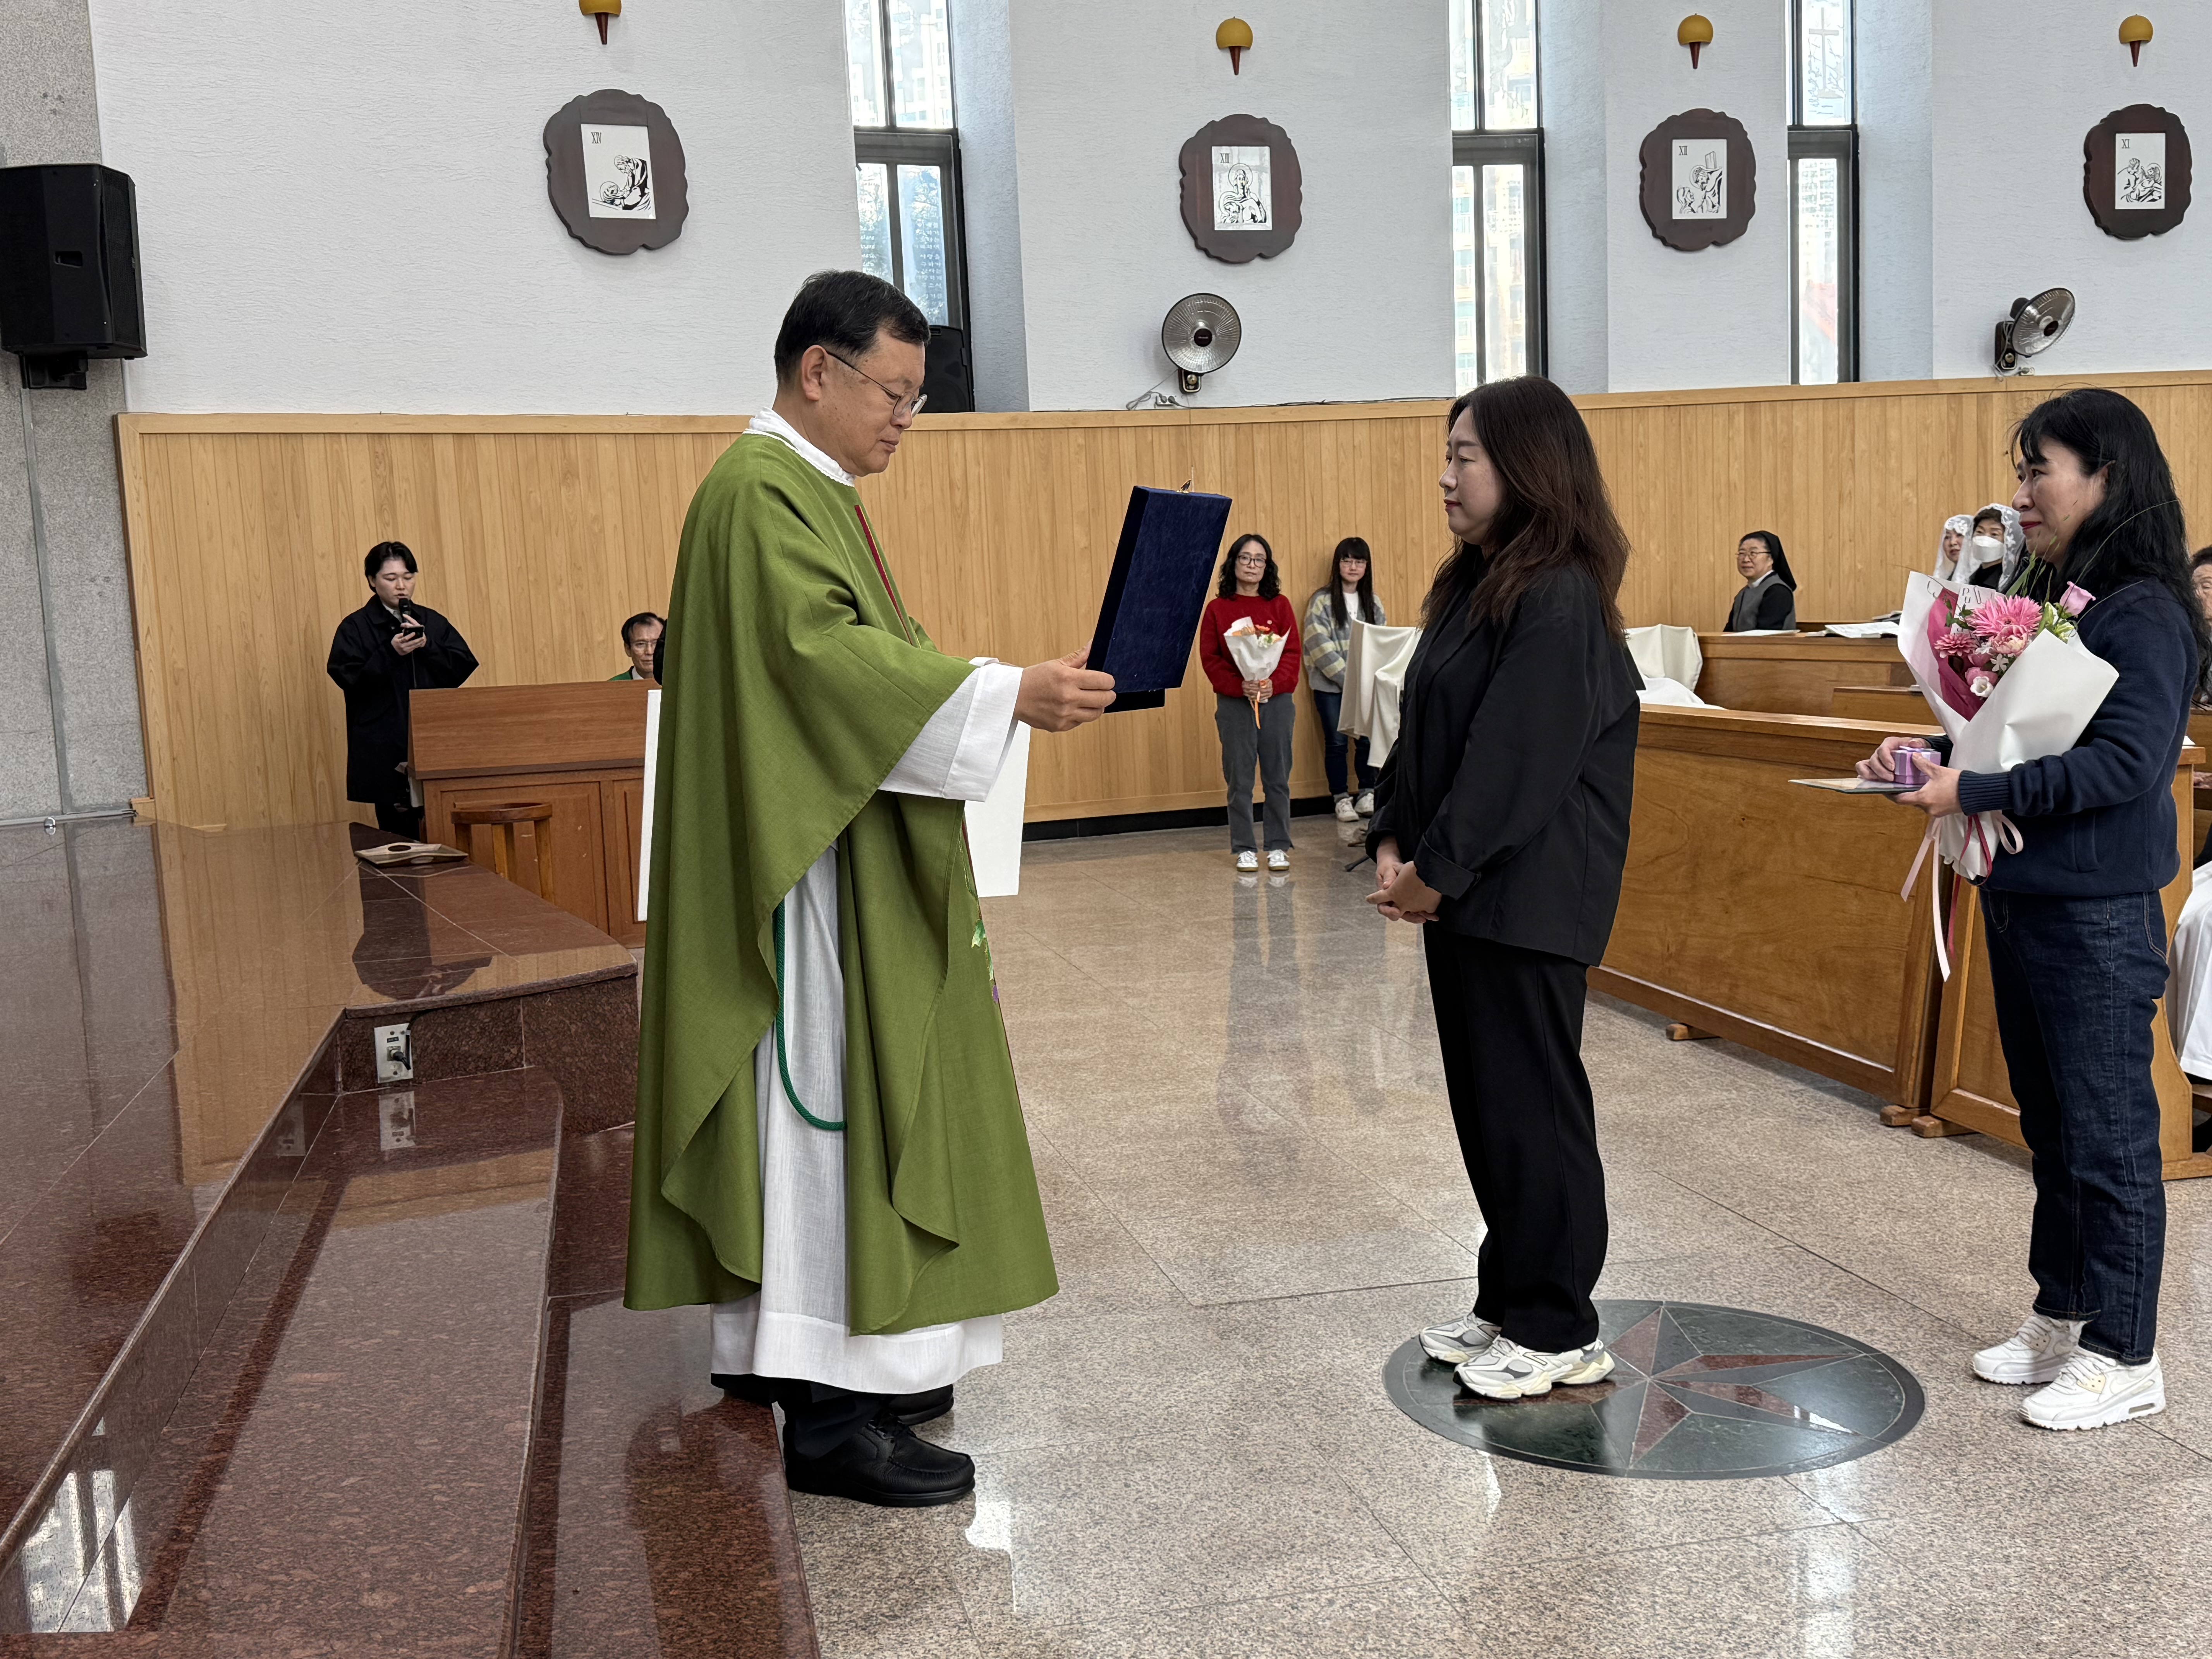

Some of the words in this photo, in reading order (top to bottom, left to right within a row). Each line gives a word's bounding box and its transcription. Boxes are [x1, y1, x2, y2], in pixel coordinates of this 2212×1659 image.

[591, 132, 602, 144] XIV
[2121, 139, 2130, 149] XI
[1220, 153, 1230, 163] XIII
